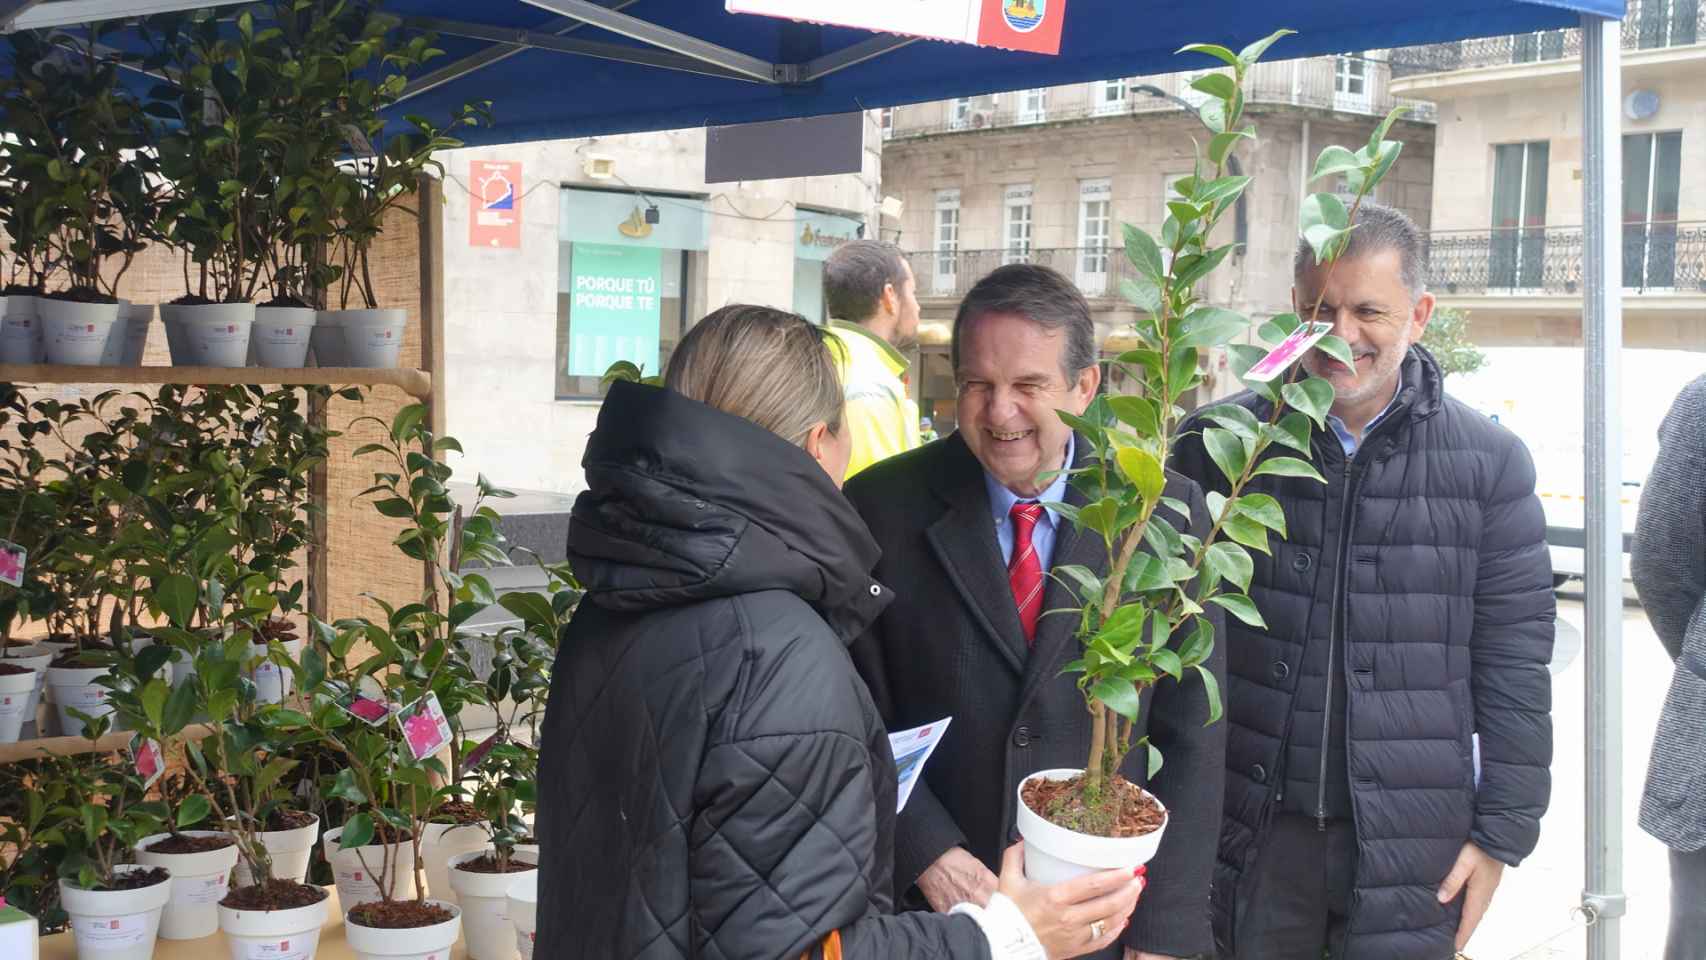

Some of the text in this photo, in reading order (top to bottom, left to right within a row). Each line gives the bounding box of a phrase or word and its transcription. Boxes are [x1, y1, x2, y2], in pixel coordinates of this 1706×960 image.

[576, 276, 656, 294] PORQUE TÚ
[576, 292, 656, 312] PORQUE TE
